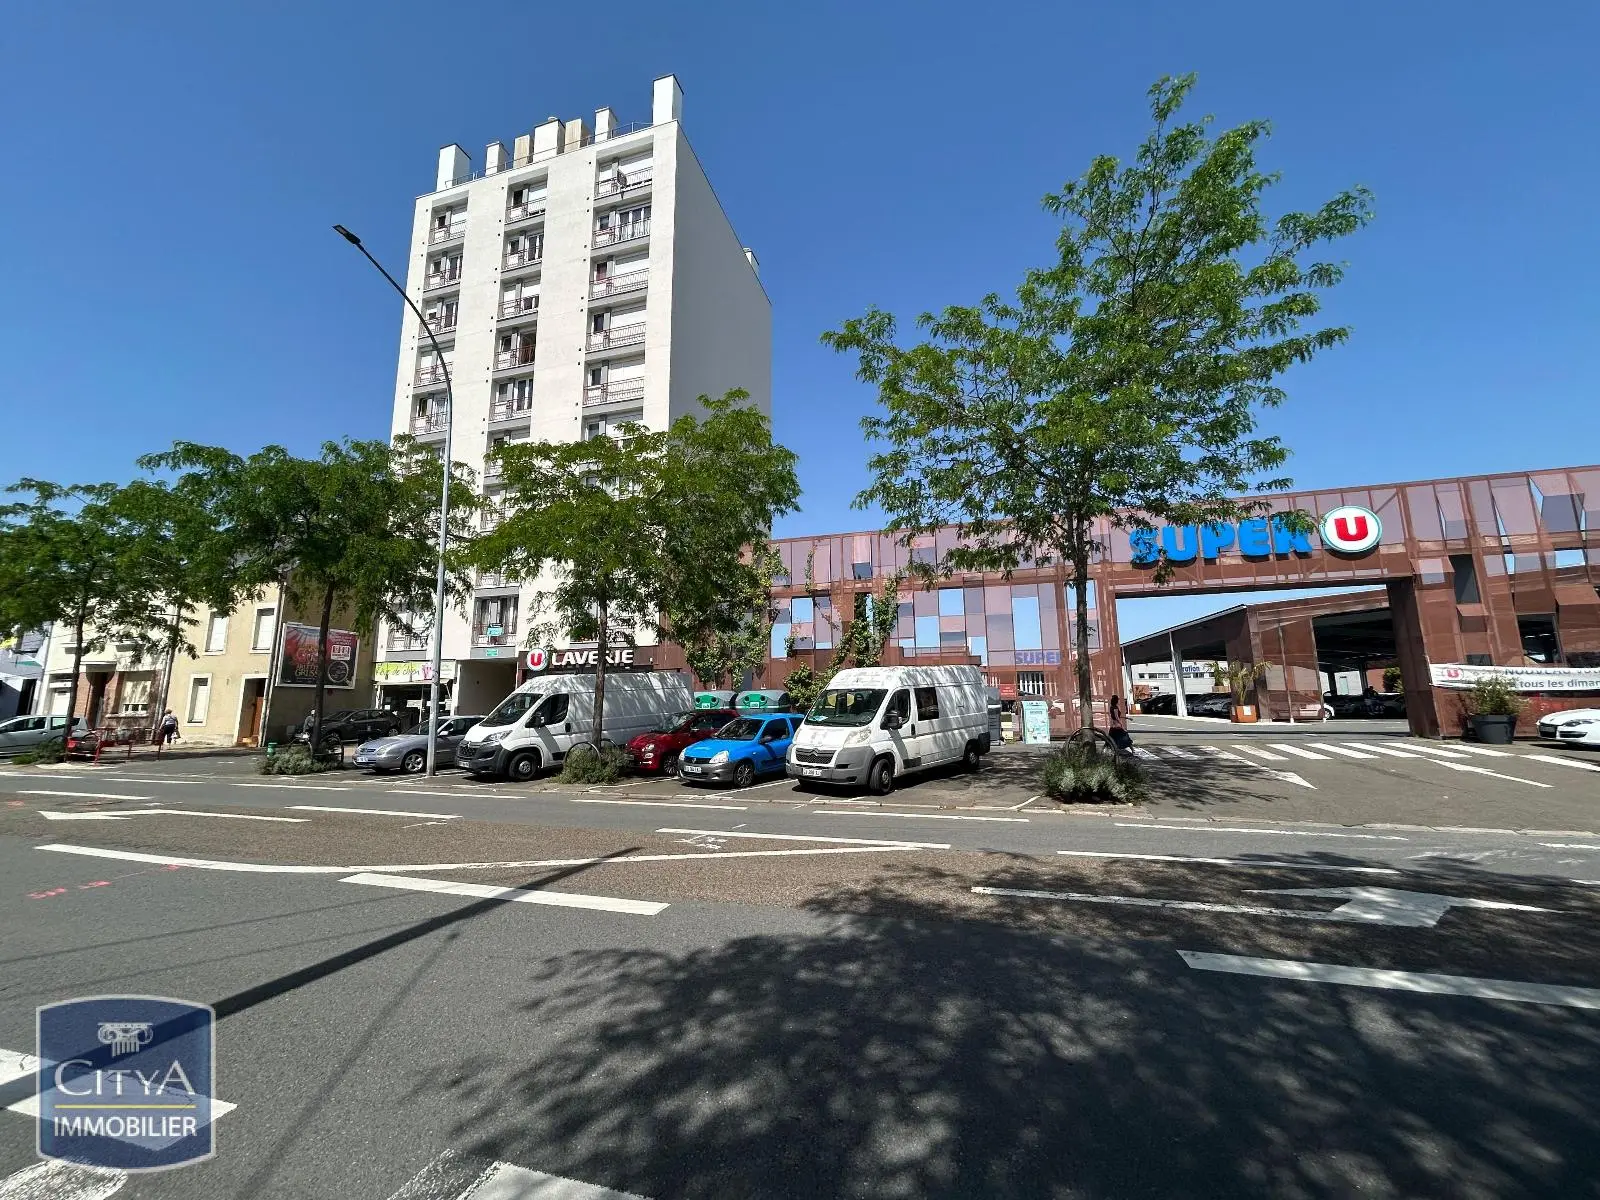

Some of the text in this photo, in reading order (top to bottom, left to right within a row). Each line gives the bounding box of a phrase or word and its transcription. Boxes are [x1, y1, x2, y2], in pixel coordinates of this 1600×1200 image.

[1129, 515, 1368, 564] SUPER U
[530, 653, 543, 667] U
[1519, 680, 1545, 688] tous
[1547, 679, 1564, 688] les
